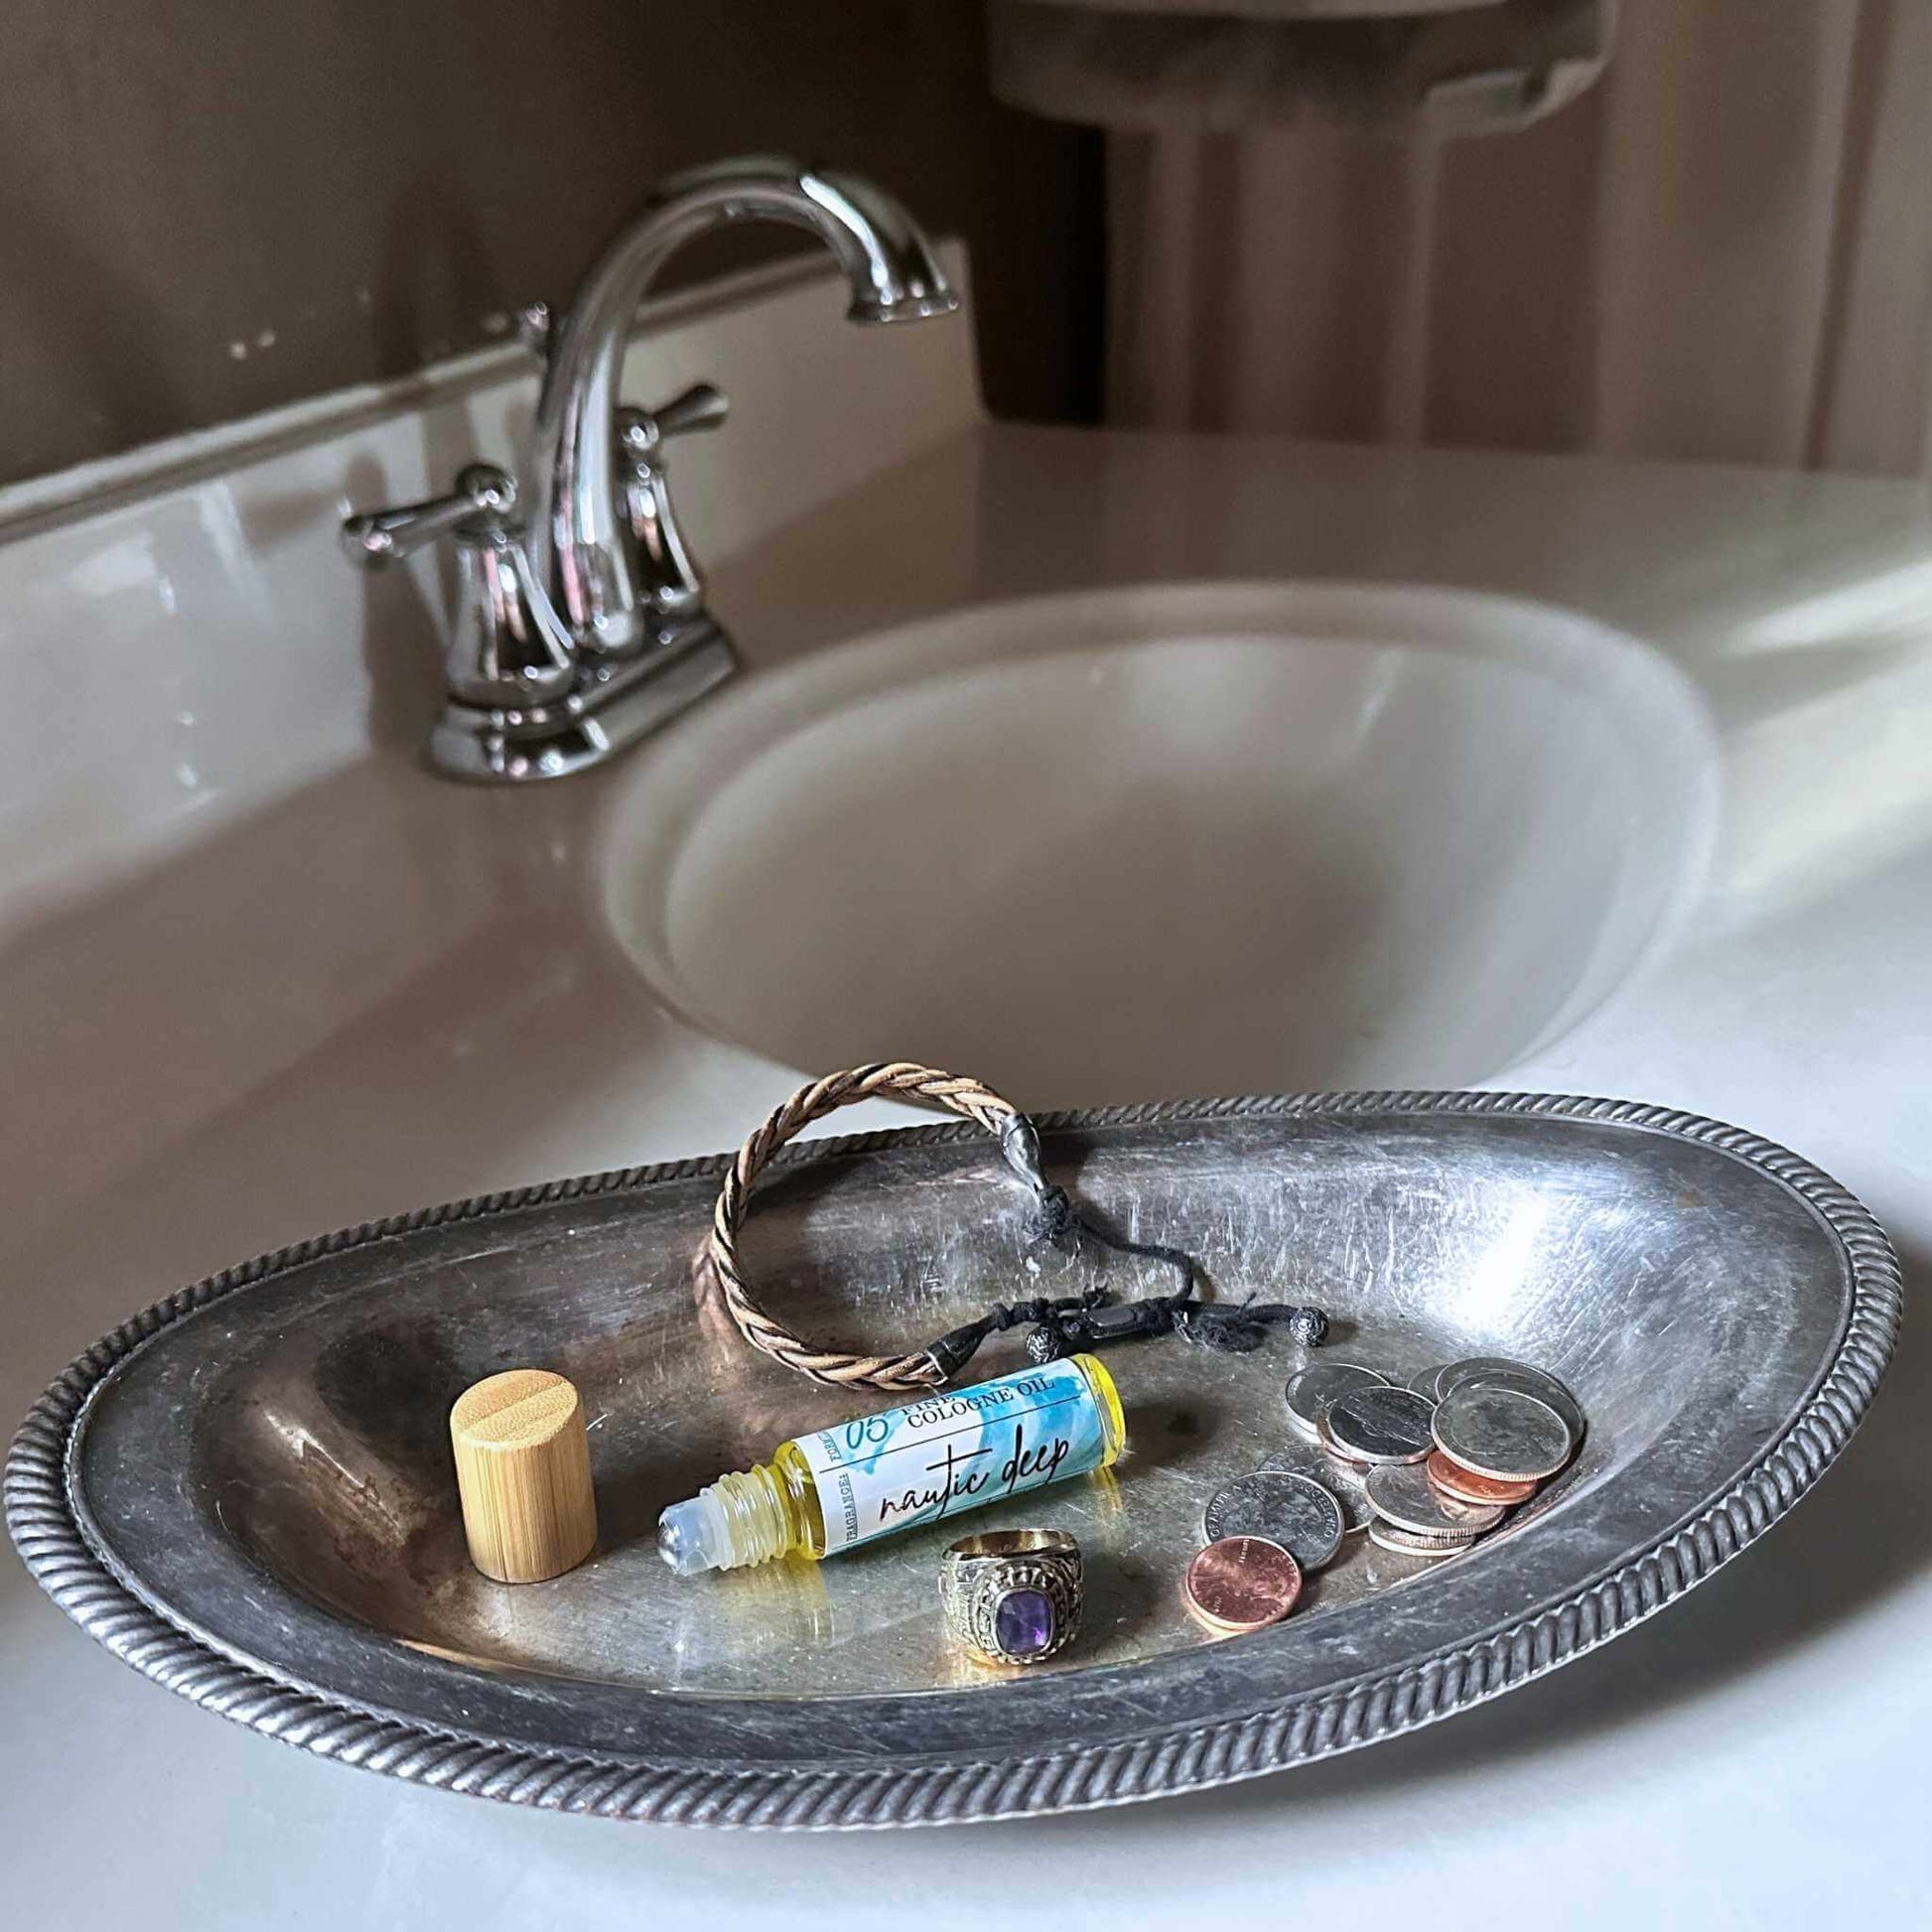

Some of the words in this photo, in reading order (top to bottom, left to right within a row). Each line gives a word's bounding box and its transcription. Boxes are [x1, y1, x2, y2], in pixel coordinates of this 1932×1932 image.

[901, 1395, 955, 1416] FINE
[907, 1388, 1014, 1429] COLOGNE
[1017, 1377, 1055, 1397] OIL
[847, 1415, 889, 1449] 05
[880, 1444, 993, 1521] nautic
[1001, 1424, 1069, 1494] deep
